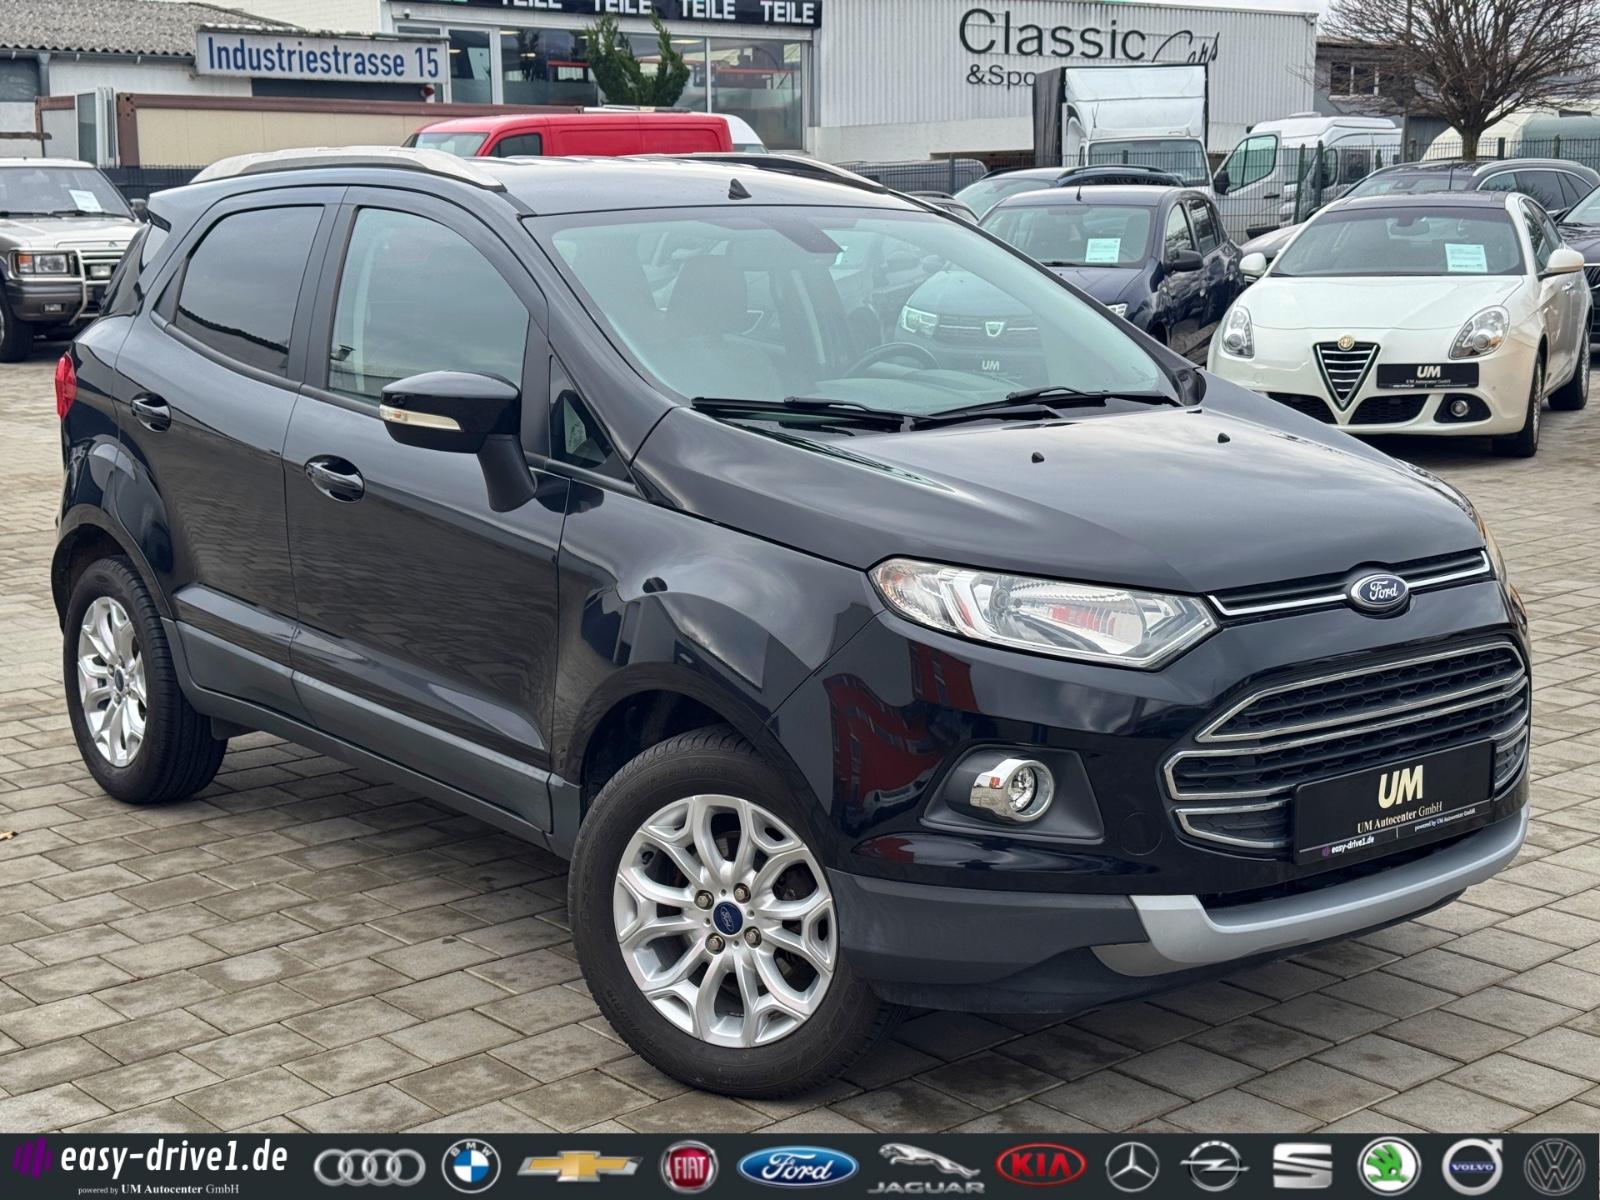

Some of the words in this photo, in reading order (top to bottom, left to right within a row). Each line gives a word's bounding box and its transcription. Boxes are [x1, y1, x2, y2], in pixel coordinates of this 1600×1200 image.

[682, 0, 736, 19] TEILE
[760, 1, 815, 24] TEILE
[959, 8, 1146, 61] Classic
[208, 37, 405, 77] Industriestrasse
[414, 47, 439, 78] 15
[982, 360, 1000, 370] UM
[1416, 366, 1441, 378] UM
[1369, 580, 1398, 601] Ford
[1378, 765, 1423, 809] UM
[1357, 820, 1373, 834] UM
[1374, 811, 1418, 830] Autocenter
[1418, 801, 1443, 817] GmbH
[1331, 835, 1375, 854] easy-drive1.de
